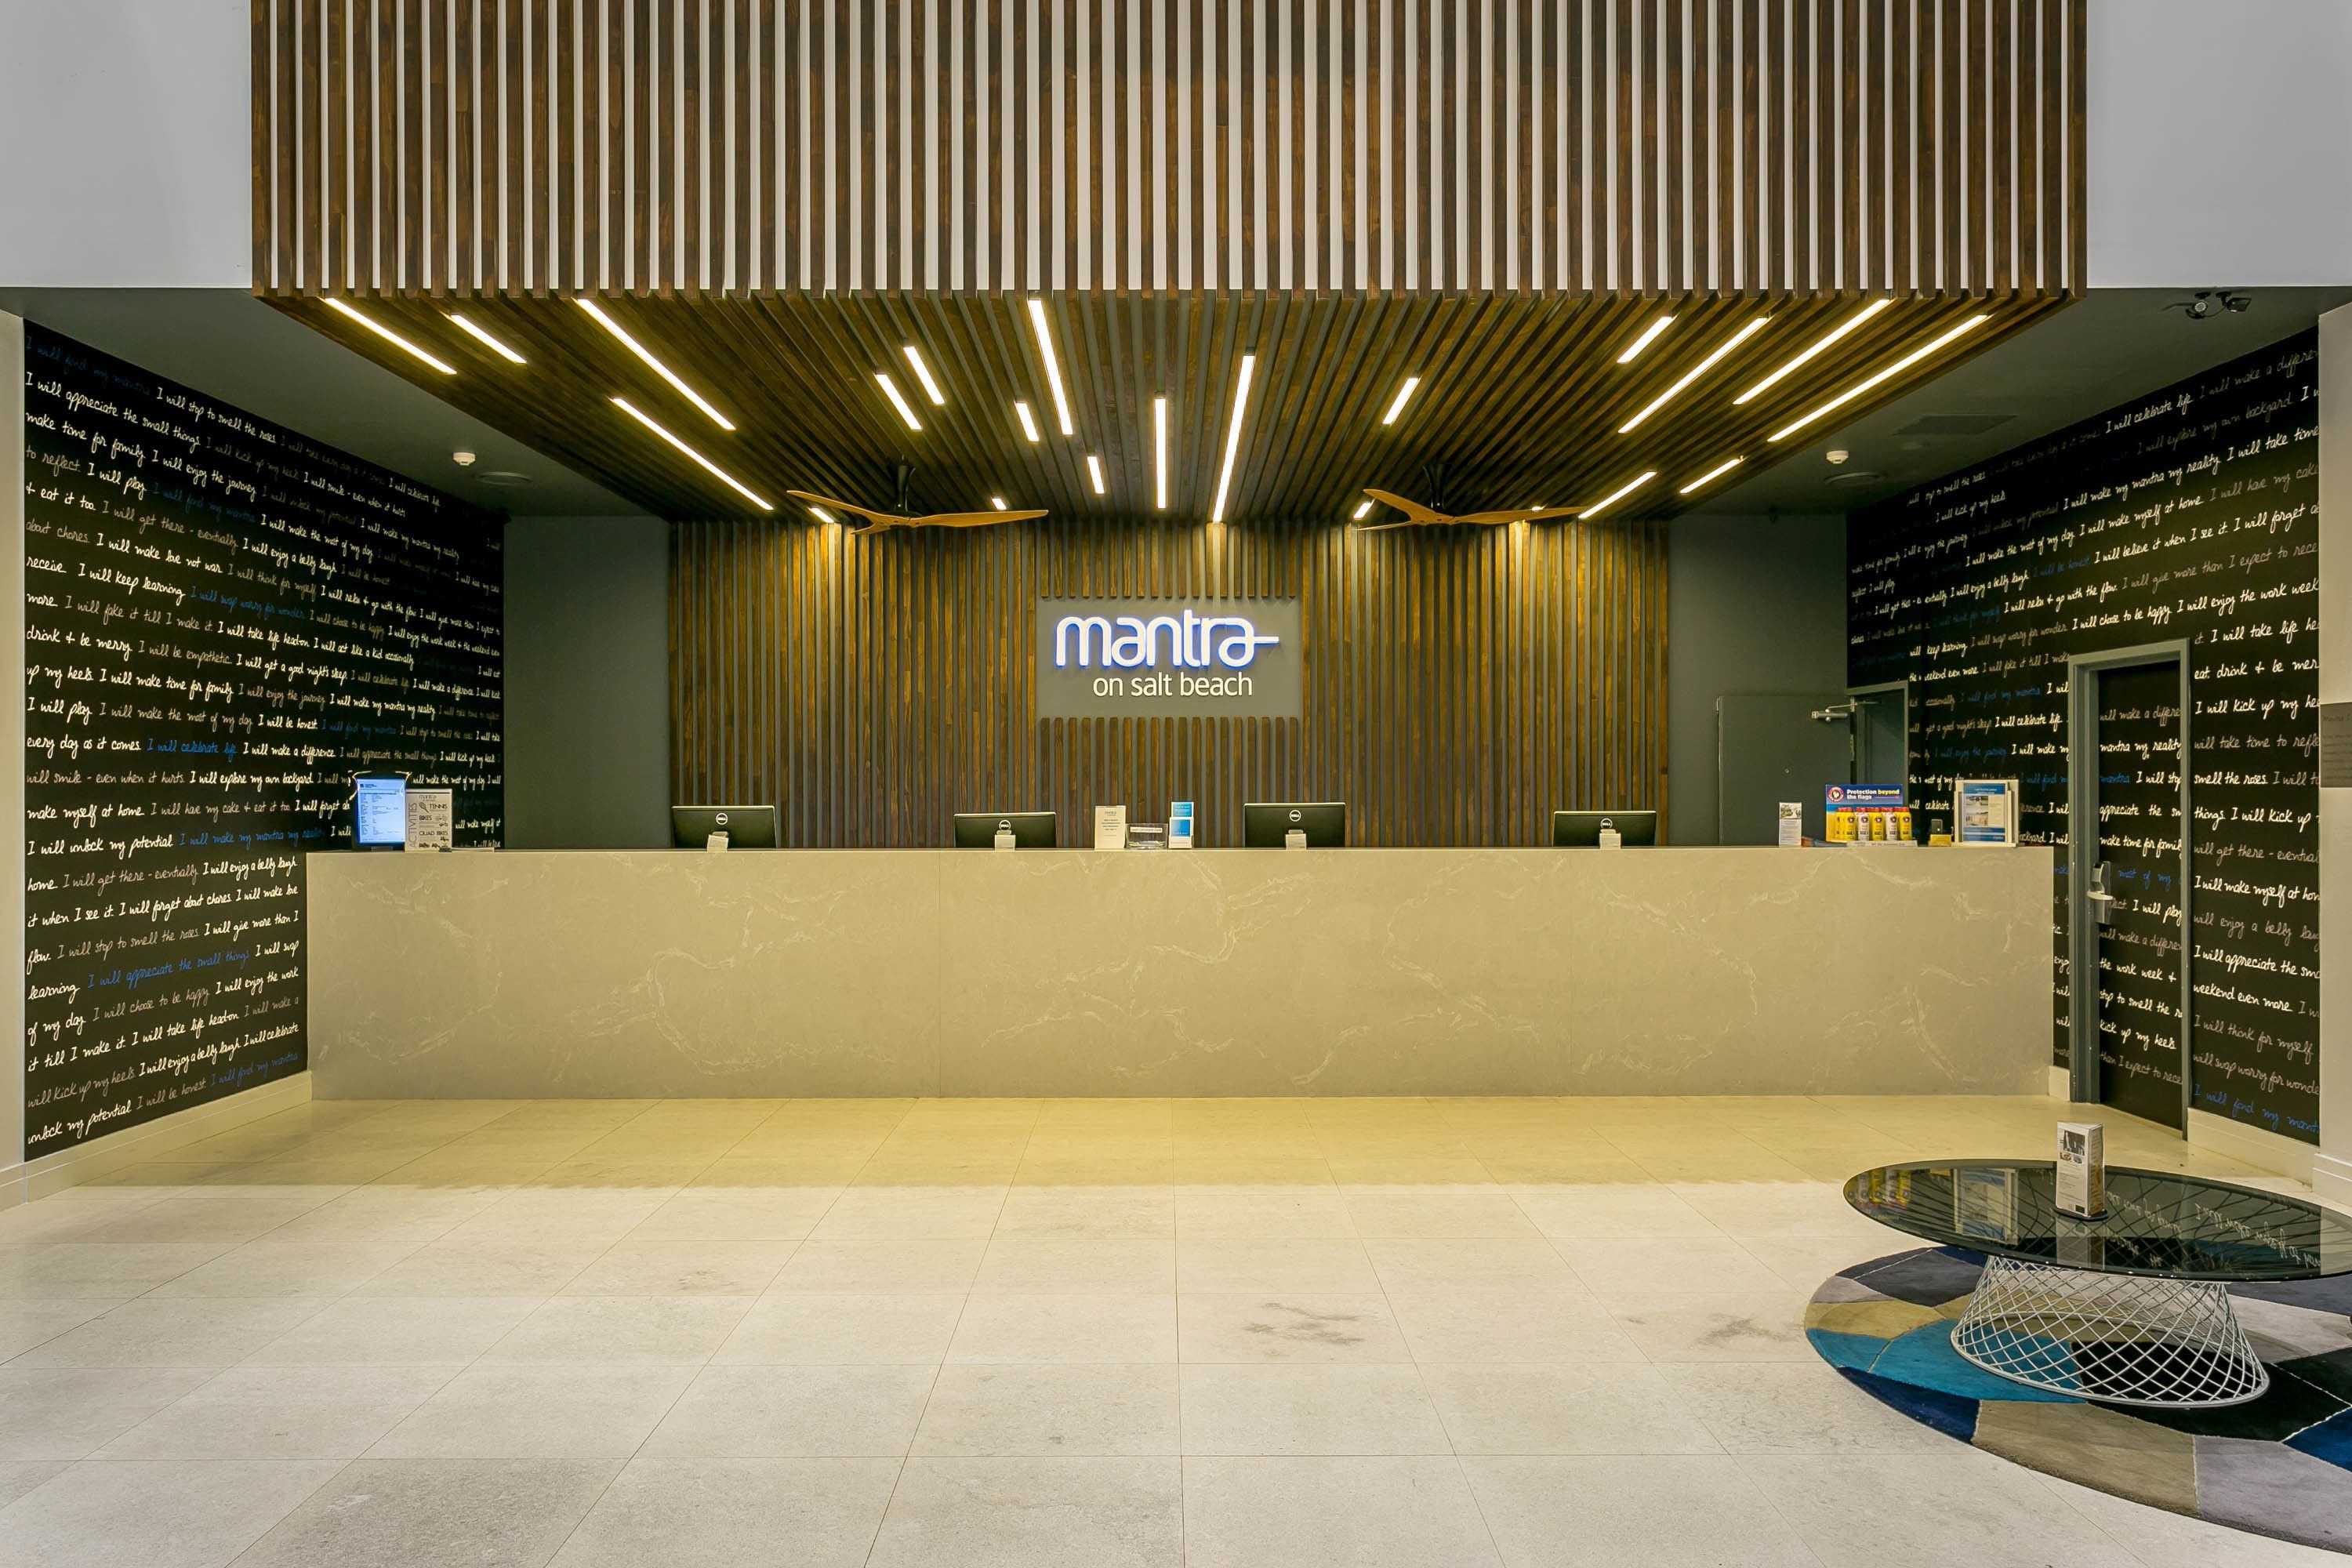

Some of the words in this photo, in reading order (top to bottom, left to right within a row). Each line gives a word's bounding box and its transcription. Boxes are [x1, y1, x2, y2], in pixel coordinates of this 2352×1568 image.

[26, 372, 32, 385] I
[38, 382, 61, 397] will
[66, 391, 118, 416] appreciate
[123, 408, 138, 423] the
[143, 417, 169, 435] small
[172, 426, 201, 453] things
[2106, 421, 2111, 433] I
[2114, 414, 2131, 430] will
[2134, 401, 2172, 423] celebrate
[2176, 394, 2193, 415] life
[26, 412, 56, 430] make
[62, 421, 87, 440] time
[92, 432, 107, 453] for
[111, 439, 146, 467] family
[152, 449, 158, 462] I
[163, 457, 182, 470] will
[187, 464, 207, 487] enjoy
[212, 470, 223, 483] the
[226, 480, 256, 502] journey
[2115, 485, 2129, 501] my
[2132, 472, 2164, 488] mantra
[2169, 468, 2183, 485] my
[2187, 454, 2220, 475] reality
[2227, 447, 2234, 461] I
[2238, 439, 2260, 457] will
[2266, 434, 2288, 449] take
[2294, 426, 2318, 441] time
[41, 488, 59, 500] eat
[64, 492, 74, 504] it
[88, 463, 94, 475] I
[100, 470, 121, 485] will
[124, 477, 147, 500] play
[2103, 547, 2120, 561] will
[2153, 538, 2161, 550] it
[2165, 534, 2186, 546] when
[2190, 528, 2196, 541] I
[2201, 528, 2213, 539] see
[2234, 517, 2240, 531] I
[2245, 512, 2267, 528] will
[2270, 503, 2306, 533] forget
[96, 533, 103, 546] I
[109, 539, 129, 553] will
[135, 546, 160, 559] make
[186, 557, 201, 568] not
[205, 564, 223, 573] war
[27, 557, 67, 572] receive
[78, 563, 85, 576] I
[90, 568, 111, 583] will
[115, 571, 139, 594] keep
[143, 577, 186, 606] learning
[27, 625, 60, 642] drink
[81, 633, 91, 646] be
[96, 639, 132, 661] merry
[1056, 609, 1279, 667] mantra
[27, 665, 39, 684] up
[45, 667, 63, 688] my
[67, 666, 93, 681] heels
[100, 669, 107, 681] I
[111, 671, 132, 685] will
[136, 674, 162, 688] make
[166, 676, 187, 690] time
[189, 680, 202, 700] for
[205, 681, 234, 703] family
[1093, 678, 1123, 696] on
[1131, 672, 1173, 696] salt
[1181, 672, 1253, 696] beach
[2217, 662, 2247, 677] drink
[2272, 659, 2283, 673] be
[2195, 702, 2201, 714] I
[2208, 700, 2227, 713] will
[2234, 699, 2256, 712] kick
[2262, 699, 2274, 720] up
[2281, 700, 2299, 720] my
[27, 738, 55, 759] every
[60, 734, 78, 759] day
[84, 739, 92, 750] as
[97, 737, 107, 749] it
[111, 741, 141, 750] comes
[2194, 771, 2222, 784] smell
[2225, 771, 2240, 784] the
[2243, 775, 2268, 784] roses
[27, 805, 57, 819] make
[63, 804, 97, 828] myself
[102, 804, 113, 817] at
[118, 804, 144, 816] home
[408, 802, 417, 848] ACTIVITIES
[2194, 807, 2225, 830] things
[2230, 808, 2238, 820] I
[2242, 808, 2264, 822] will
[2269, 809, 2292, 822] kick
[2298, 813, 2311, 833] up
[27, 841, 34, 855] I
[42, 840, 64, 854] will
[71, 838, 103, 852] unlock
[110, 841, 125, 859] my
[27, 913, 38, 927] it
[42, 911, 69, 925] when
[74, 908, 81, 921] I
[85, 910, 100, 920] see
[119, 902, 125, 916] I
[129, 900, 150, 914] will
[152, 897, 181, 921] forget
[184, 895, 204, 908] about
[207, 893, 232, 905] chores
[28, 983, 80, 1004] learning
[88, 975, 94, 988] I
[100, 970, 121, 985] will
[126, 963, 173, 989] appreciate
[180, 958, 191, 970] the
[198, 953, 220, 967] small
[226, 950, 249, 969] things
[2194, 946, 2201, 957] I
[2203, 949, 2223, 962] will
[2226, 955, 2277, 973] appreciate
[2281, 960, 2297, 975] the
[2194, 983, 2235, 1000] weekend
[2238, 993, 2259, 1004] even
[2263, 998, 2292, 1011] more
[28, 1022, 38, 1046] of
[43, 1022, 60, 1040] my
[66, 1012, 86, 1035] day
[28, 1057, 38, 1072] it
[45, 1050, 64, 1067] till
[70, 1047, 77, 1061] I
[83, 1041, 111, 1057] make
[132, 1032, 138, 1045] I
[143, 1026, 162, 1042] will
[167, 1022, 186, 1036] take
[28, 1122, 62, 1144] unlock
[67, 1120, 84, 1138] my
[85, 1100, 132, 1135] potential
